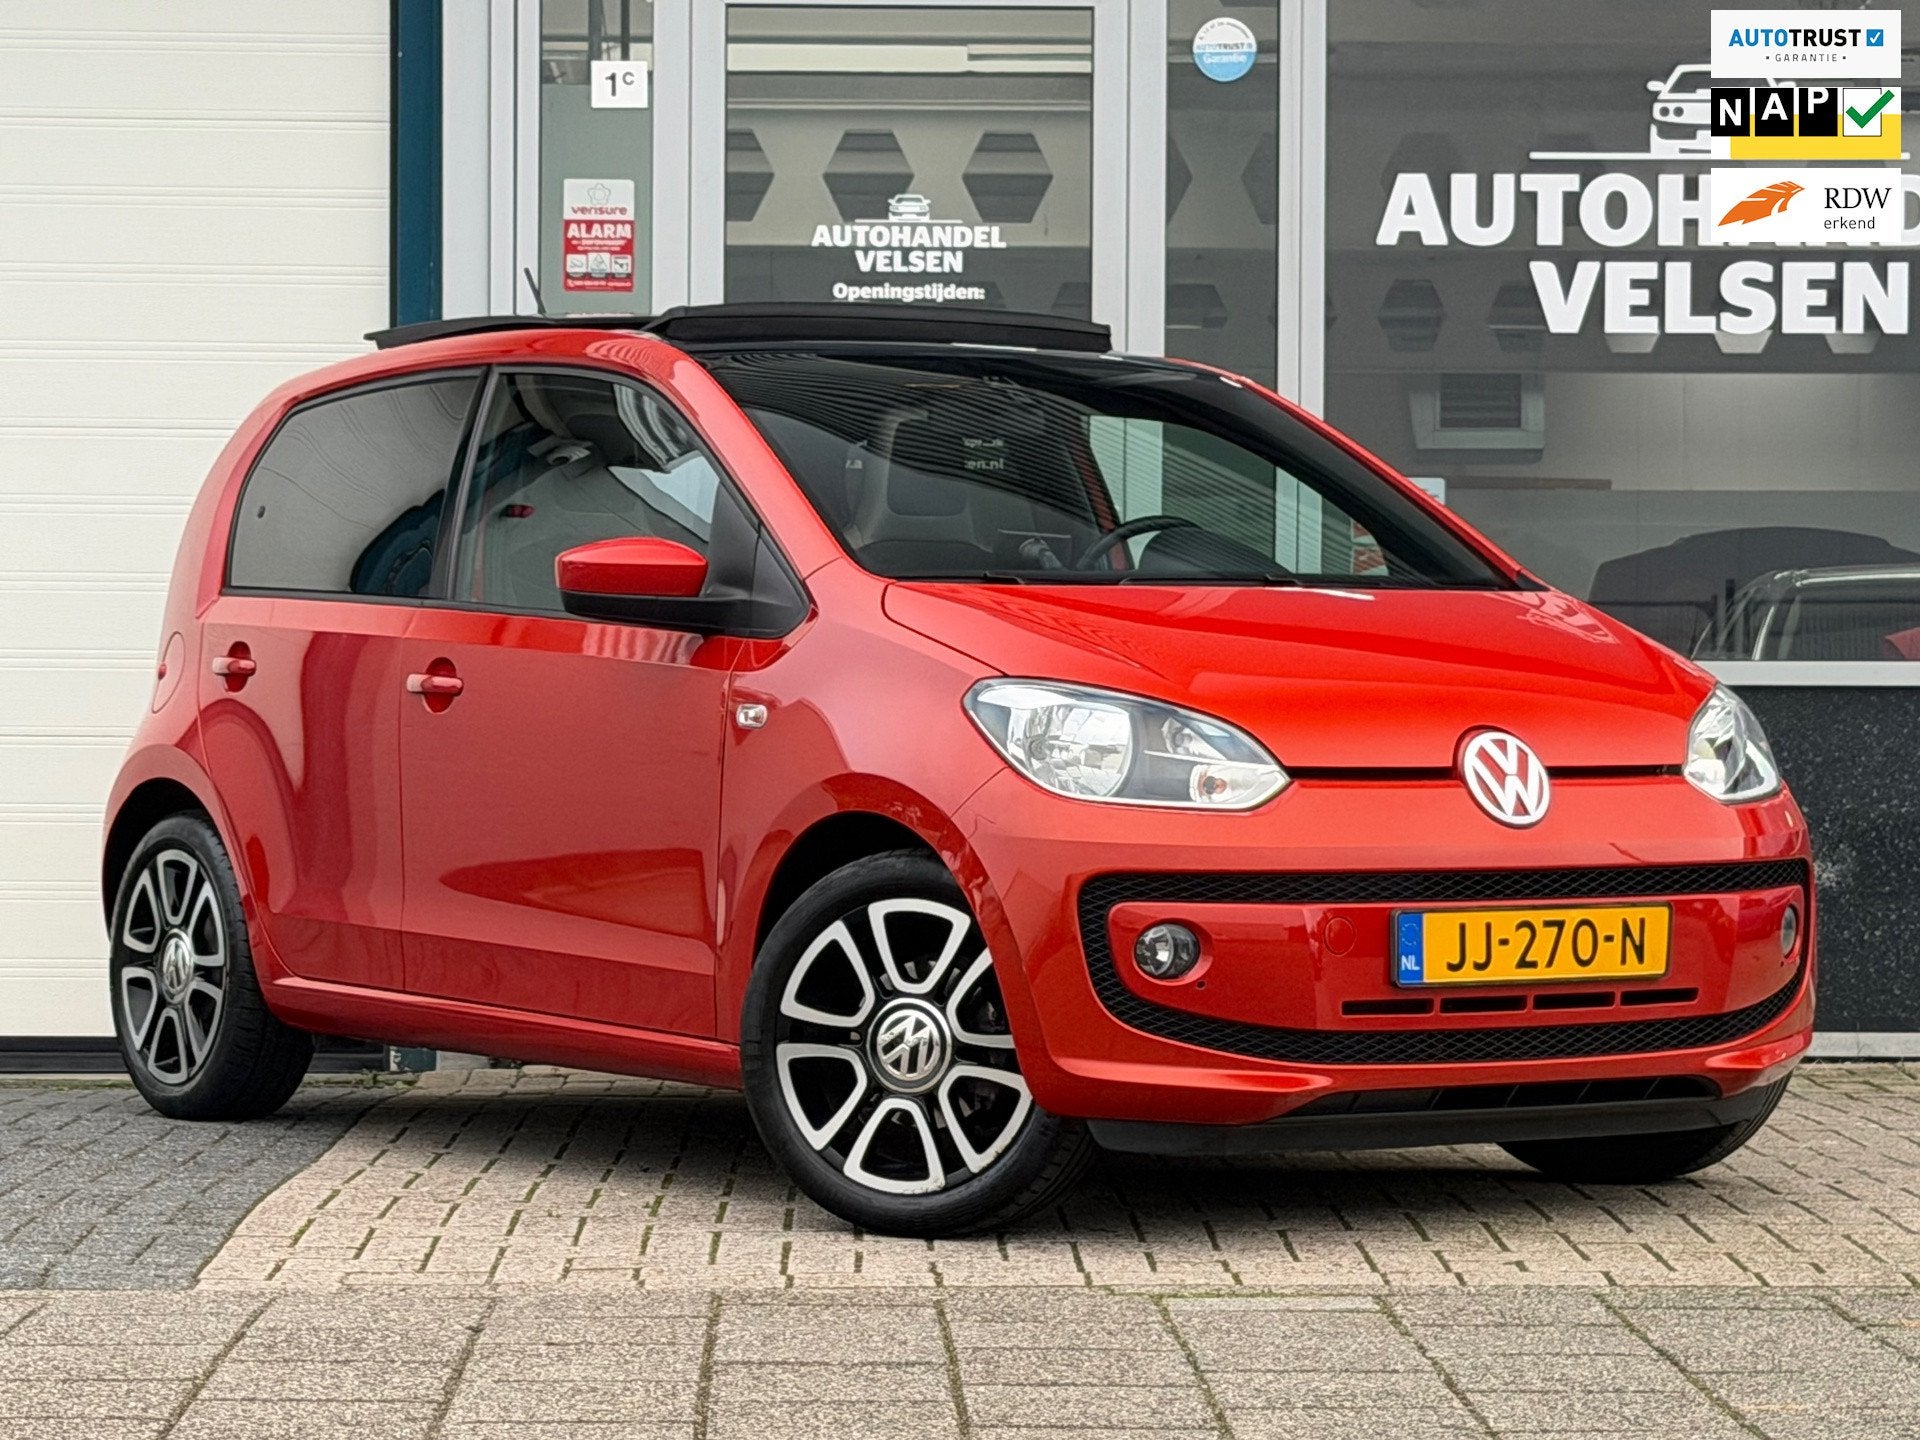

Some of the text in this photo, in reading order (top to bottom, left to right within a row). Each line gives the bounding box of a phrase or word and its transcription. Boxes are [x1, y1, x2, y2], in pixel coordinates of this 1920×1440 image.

[571, 206, 628, 215] verisure
[567, 223, 632, 239] ALARM
[811, 224, 1007, 249] AUTOHANDEL
[855, 250, 963, 273] VELSEN
[832, 282, 986, 303] Openingstijden:
[1529, 260, 1910, 335] VELSEN
[1446, 917, 1646, 972] JJ-270-N
[1401, 958, 1421, 971] NL
